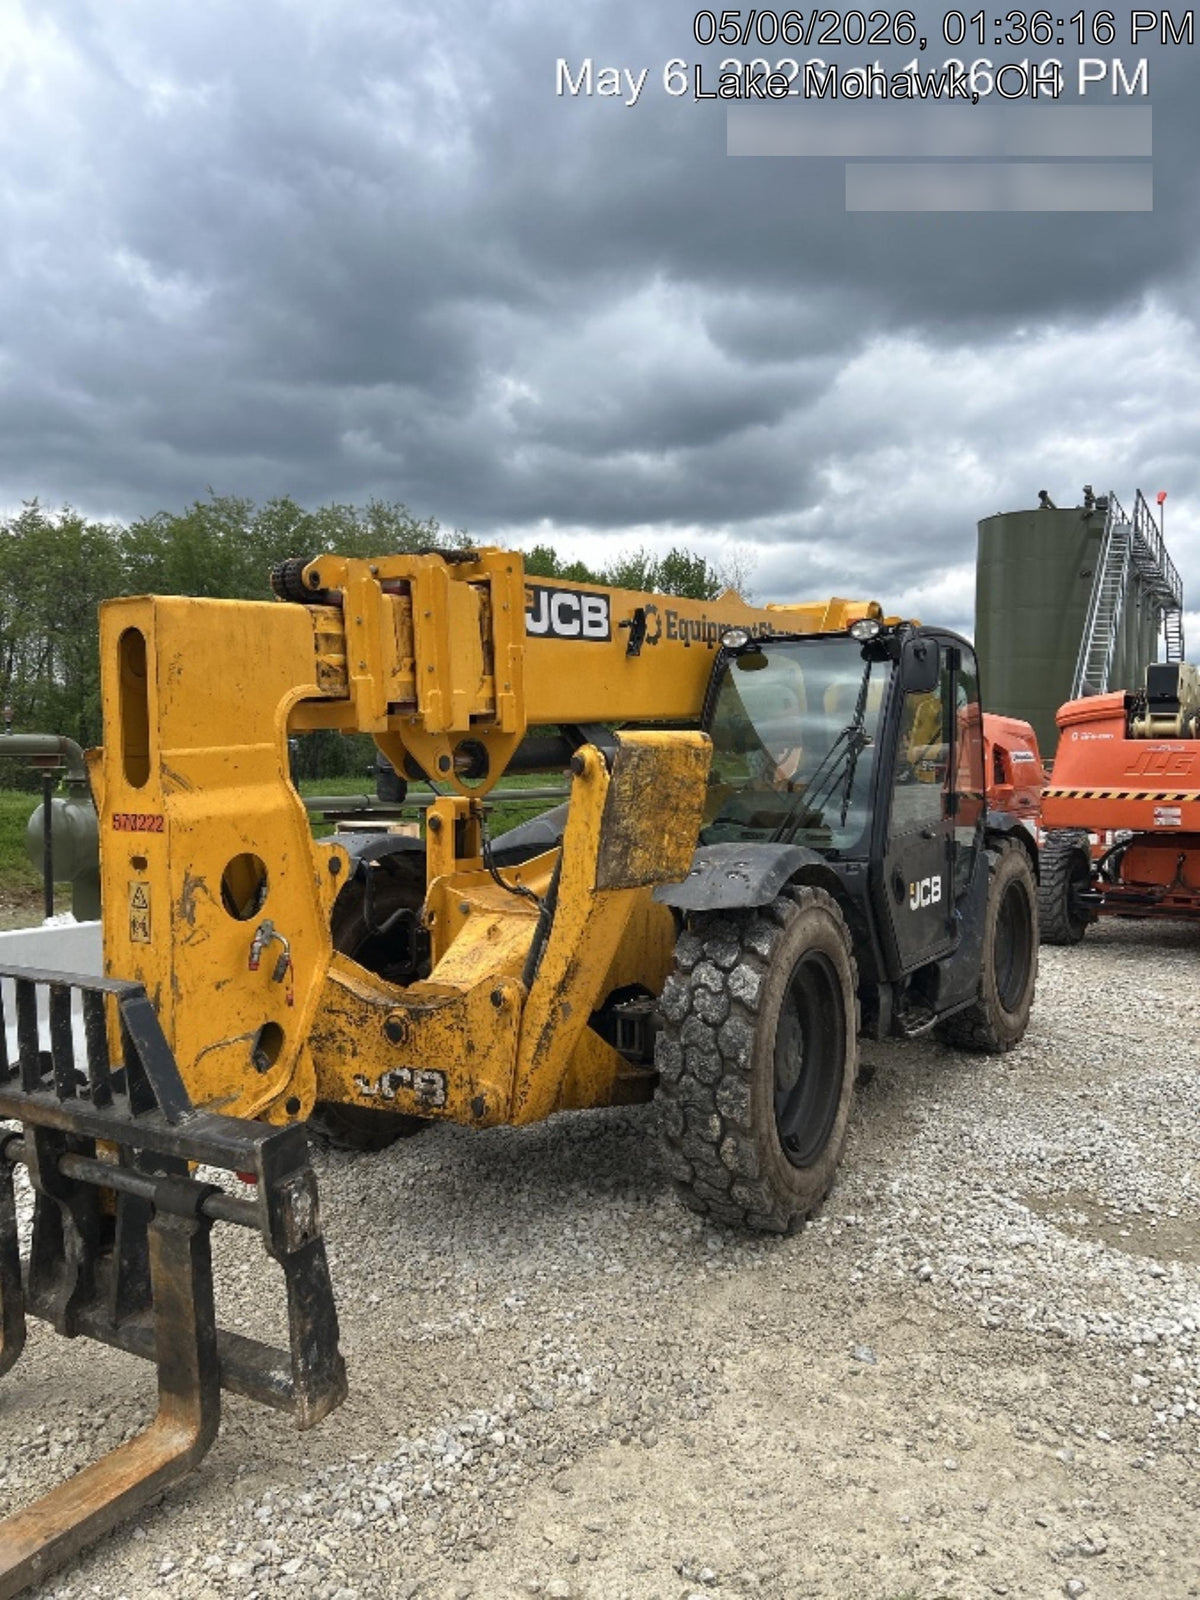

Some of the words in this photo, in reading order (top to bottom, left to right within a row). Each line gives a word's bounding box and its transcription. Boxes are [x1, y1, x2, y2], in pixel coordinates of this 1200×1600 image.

[525, 591, 610, 637] JCB
[1123, 751, 1197, 776] JLG
[113, 813, 165, 833] 573222
[909, 875, 942, 911] JCB
